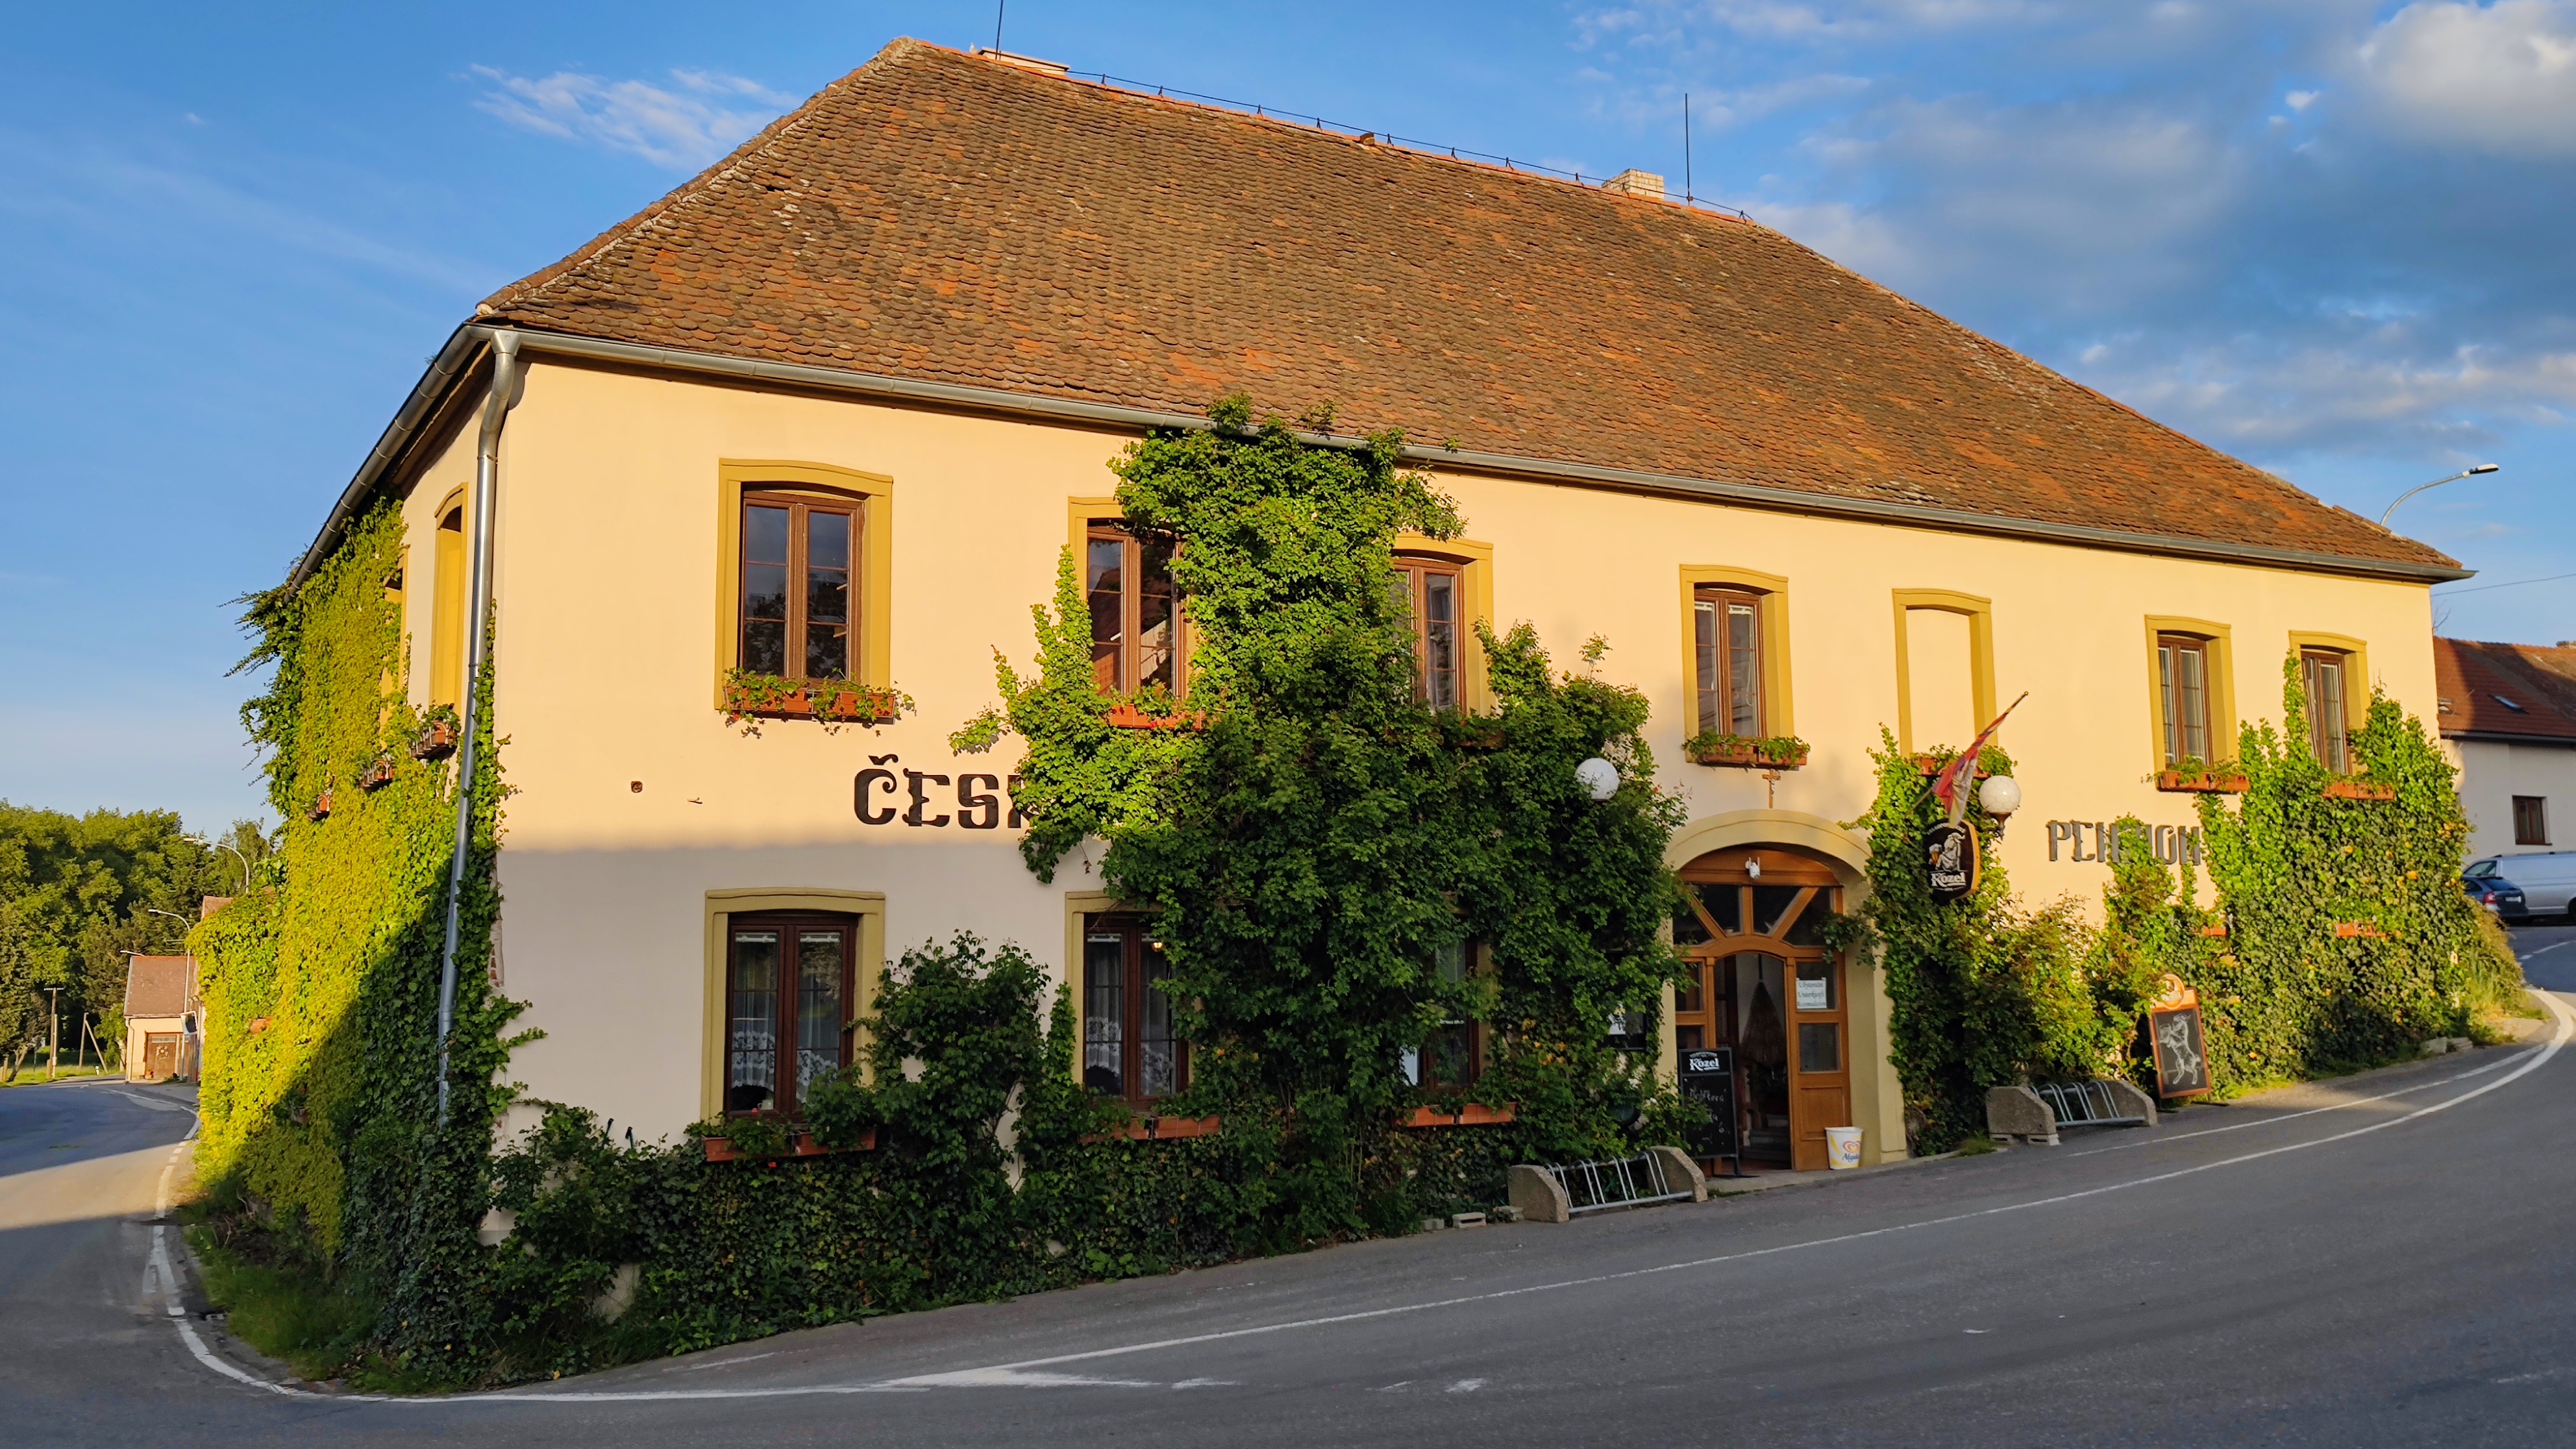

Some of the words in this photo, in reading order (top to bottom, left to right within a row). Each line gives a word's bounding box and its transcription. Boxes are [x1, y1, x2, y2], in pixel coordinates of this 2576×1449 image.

[2046, 820, 2201, 865] PENION
[1931, 872, 1966, 887] Kozel
[1689, 1058, 1720, 1072] Kozel
